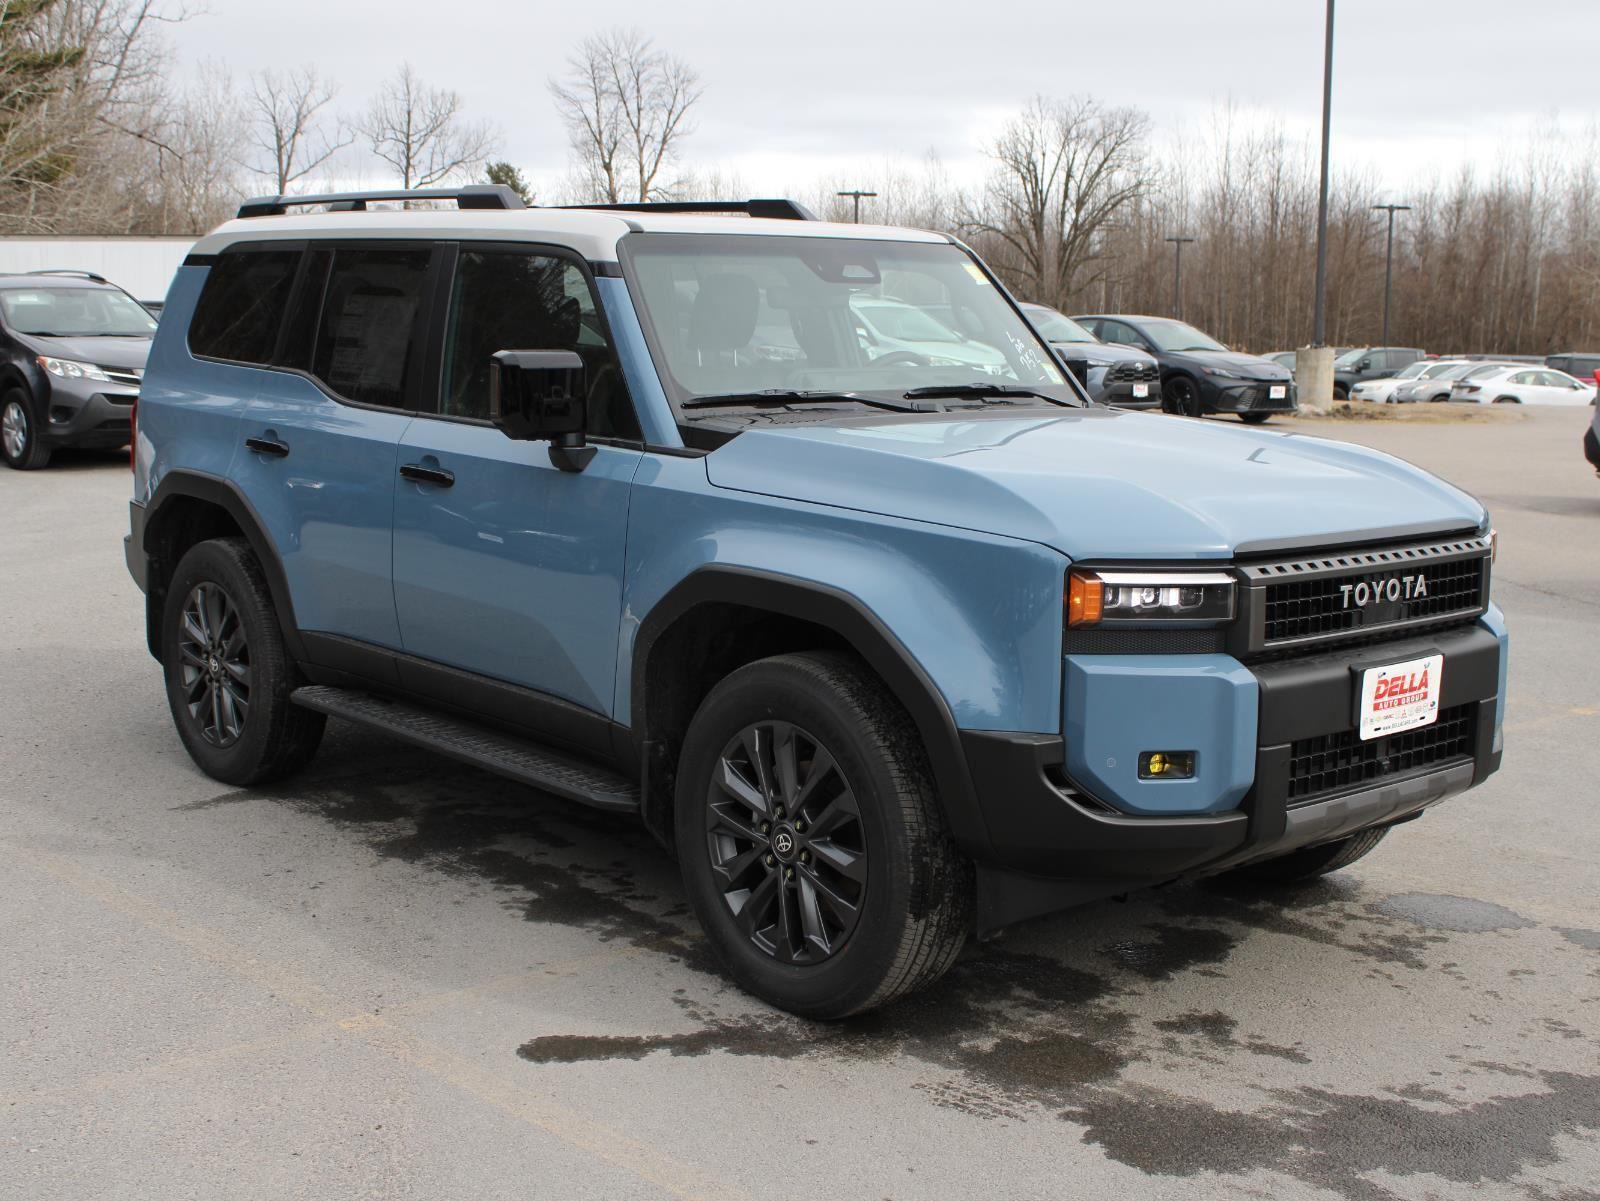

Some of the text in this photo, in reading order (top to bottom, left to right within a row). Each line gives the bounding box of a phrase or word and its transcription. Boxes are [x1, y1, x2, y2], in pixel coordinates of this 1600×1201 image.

[1340, 574, 1427, 609] TOYOTA
[1374, 669, 1428, 700] DELLA
[1378, 693, 1424, 710] AUTO GROUP
